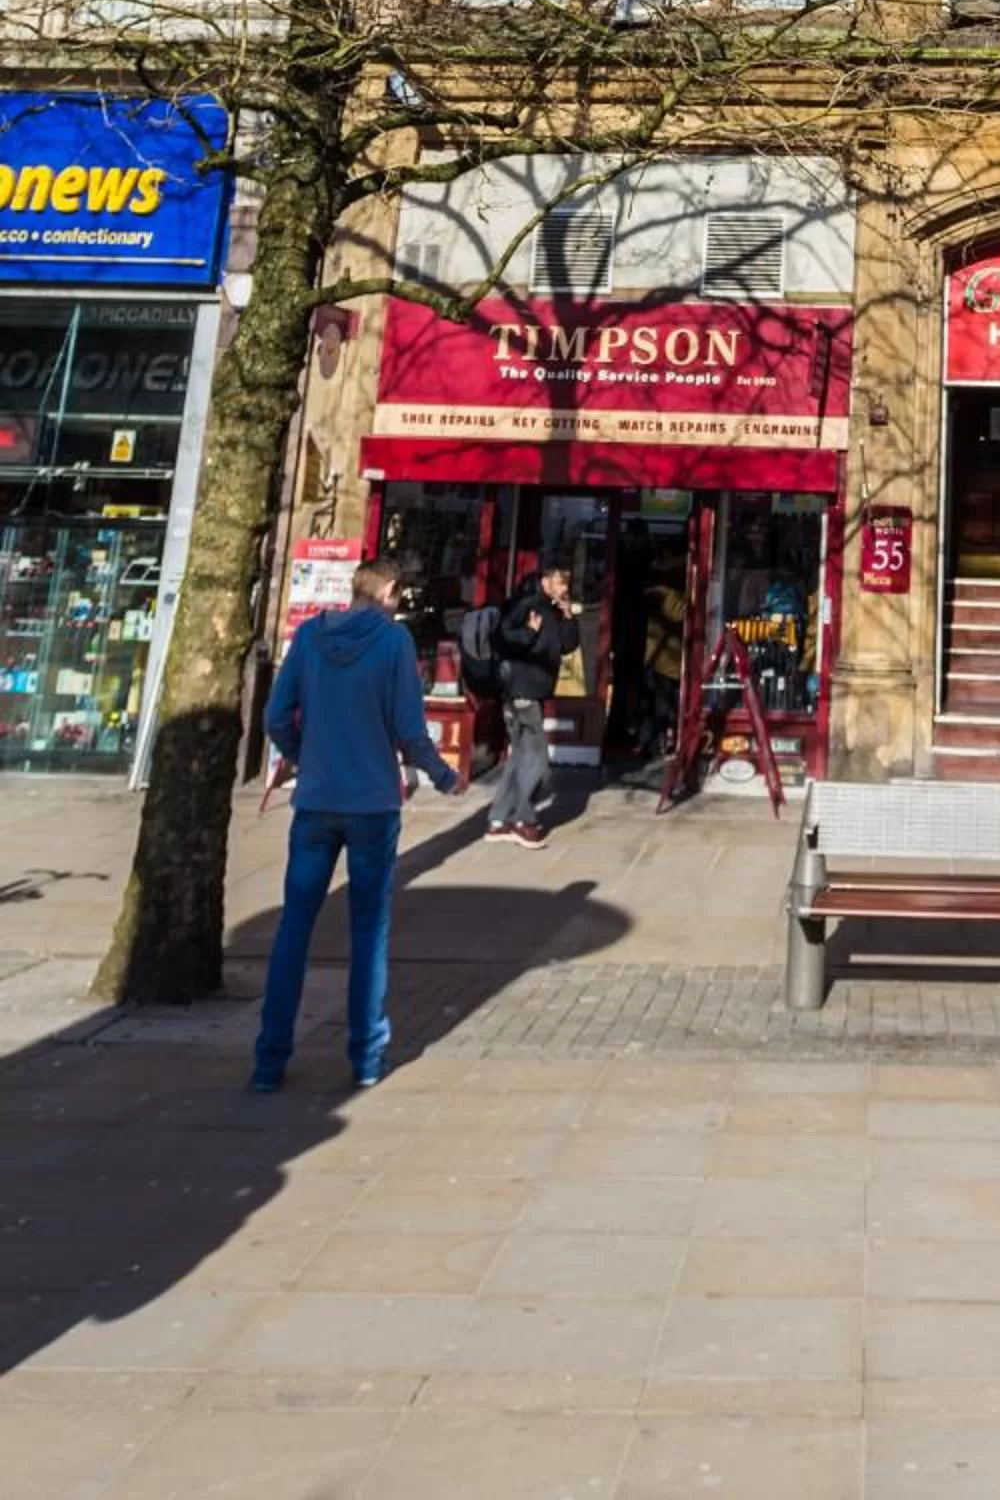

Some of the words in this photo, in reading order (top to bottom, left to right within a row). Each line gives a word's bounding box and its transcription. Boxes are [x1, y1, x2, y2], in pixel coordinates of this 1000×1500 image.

[42, 228, 153, 248] confectionary
[489, 324, 743, 366] TIMPSON
[500, 366, 528, 379] The
[534, 367, 592, 383] Quality
[597, 369, 659, 383] Service
[665, 372, 721, 386] People
[401, 412, 433, 425] SHOE
[440, 413, 495, 427] REPAIRS
[512, 416, 537, 428] KEY
[544, 417, 600, 430] CUTTING
[618, 419, 663, 432] WATCH
[670, 421, 726, 434] REPAIRS
[744, 422, 821, 436] ENGRAVING
[871, 541, 903, 571] 55
